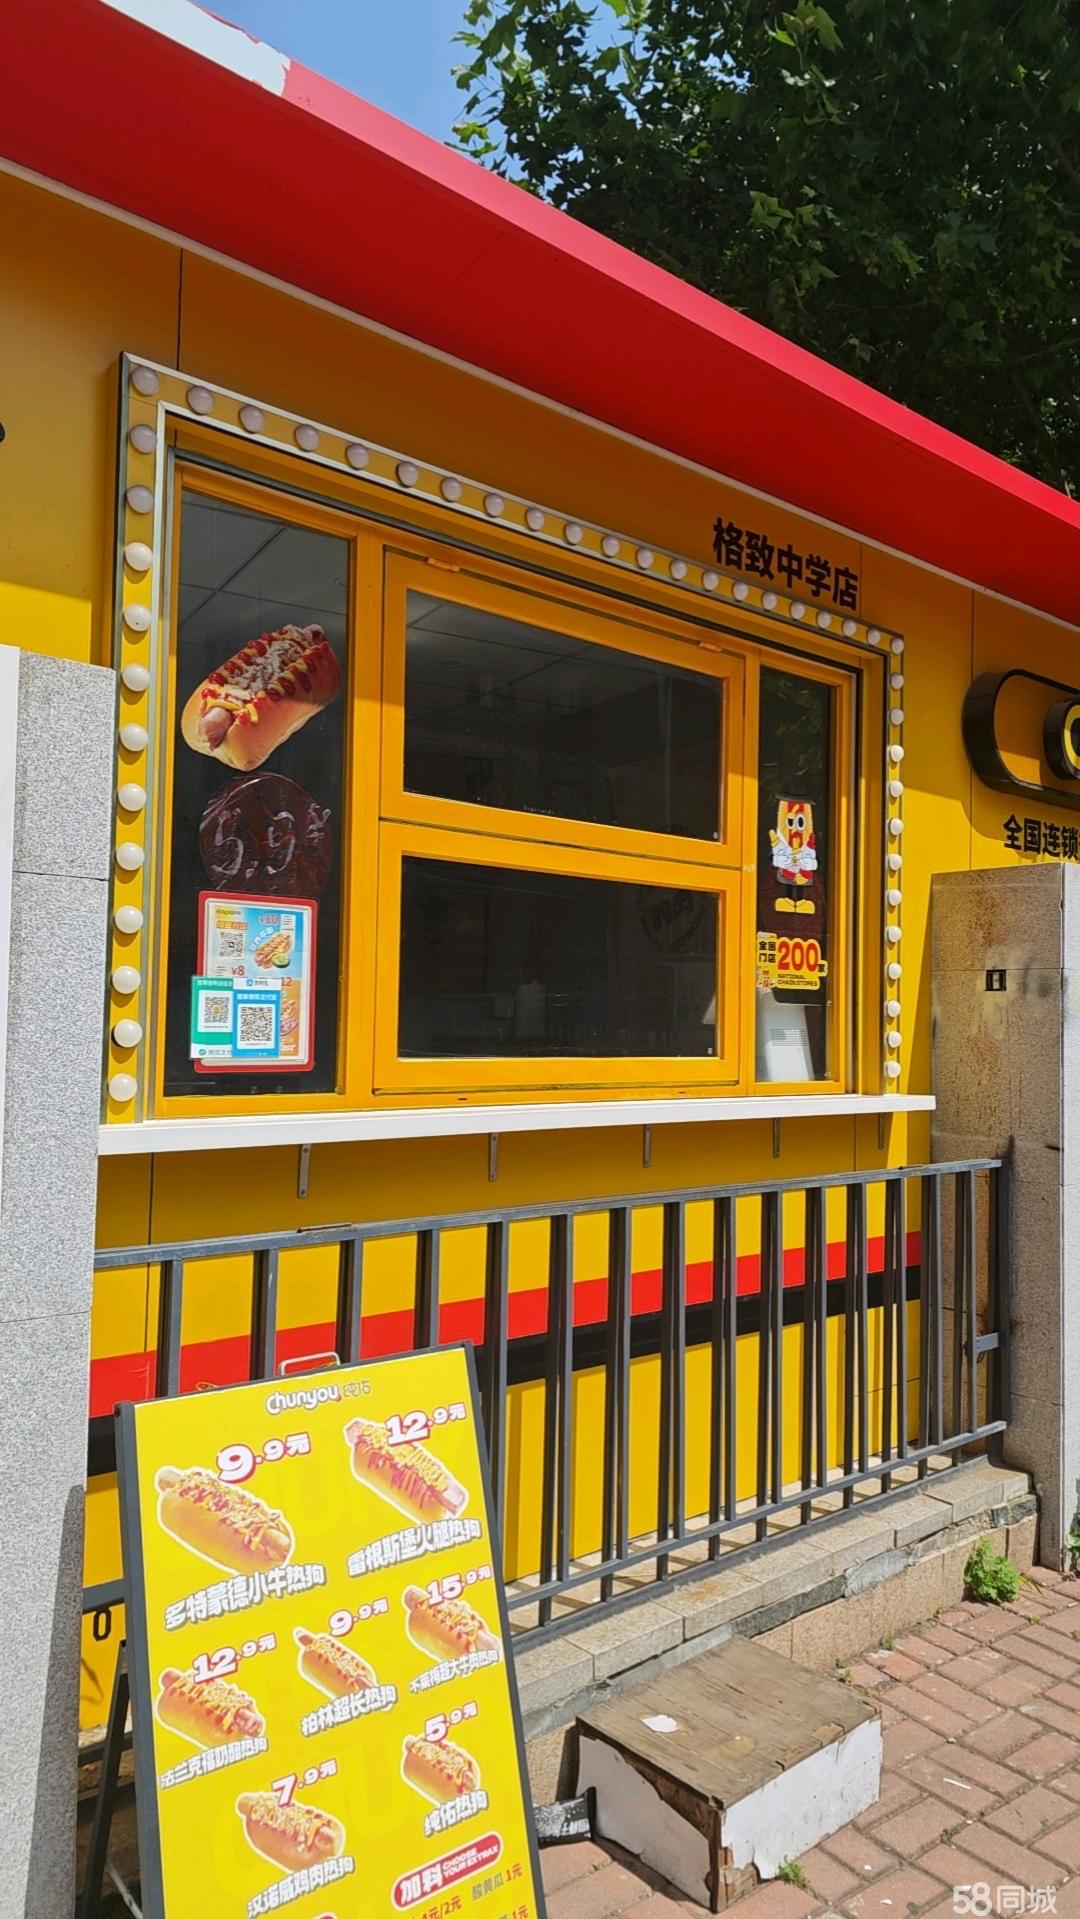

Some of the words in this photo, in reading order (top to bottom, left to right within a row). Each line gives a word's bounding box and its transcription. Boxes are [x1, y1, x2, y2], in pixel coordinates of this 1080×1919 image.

[713, 517, 859, 611] 格致中学店
[1003, 815, 1080, 861] 全国连锁
[777, 941, 819, 972] 200
[385, 1402, 467, 1446] 12.9元
[216, 1432, 311, 1484] 9.9元
[165, 1564, 326, 1631] 多特蒙德小牛热狗
[426, 1565, 492, 1605] 15.9元
[329, 1597, 389, 1638] 9.9元
[192, 1633, 277, 1684] 12.9元
[301, 1684, 398, 1737] 柏林超长热狗
[424, 1700, 478, 1743] 5.9元
[272, 1758, 337, 1808] 7.9元
[442, 1847, 477, 1871] CHOOSE
[443, 1862, 466, 1879] YOUR
[400, 1863, 443, 1905] 加料
